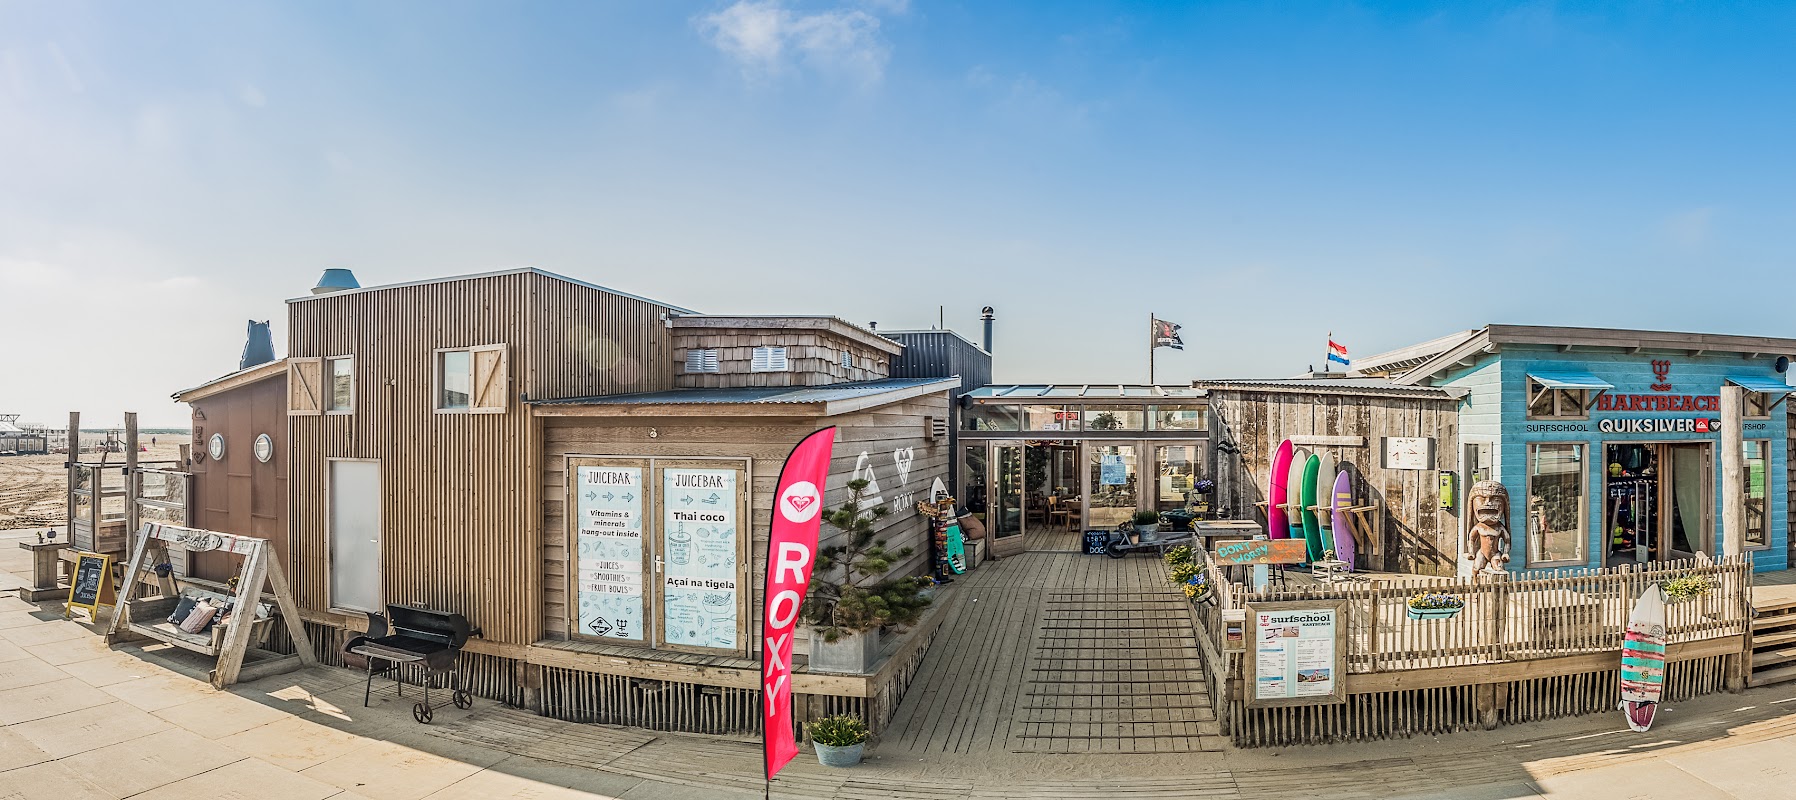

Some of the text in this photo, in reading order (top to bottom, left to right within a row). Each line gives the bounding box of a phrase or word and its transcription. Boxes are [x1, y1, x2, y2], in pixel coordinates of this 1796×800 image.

[1596, 394, 1721, 411] HARTBEACH
[1055, 412, 1078, 420] OPEN
[1526, 424, 1589, 432] SURFSCHOOL
[1598, 418, 1696, 433] QUIKSILVER
[588, 471, 631, 485] JUICEBAR
[675, 474, 723, 488] JUICEBAR
[893, 491, 915, 515] ROXY
[590, 509, 622, 517] Vitamins
[673, 512, 725, 522] Thai coco
[593, 519, 626, 528] minerals
[581, 528, 615, 537] hang-out
[1231, 544, 1269, 563] WORRY
[600, 561, 619, 570] JUICES
[593, 572, 626, 582] SMOOTHIES
[591, 583, 629, 594] FRUIT BOWLS
[667, 577, 689, 588] Açaí
[704, 579, 735, 590] tigela
[1271, 614, 1331, 624] surfschool
[765, 541, 810, 717] ROXY
